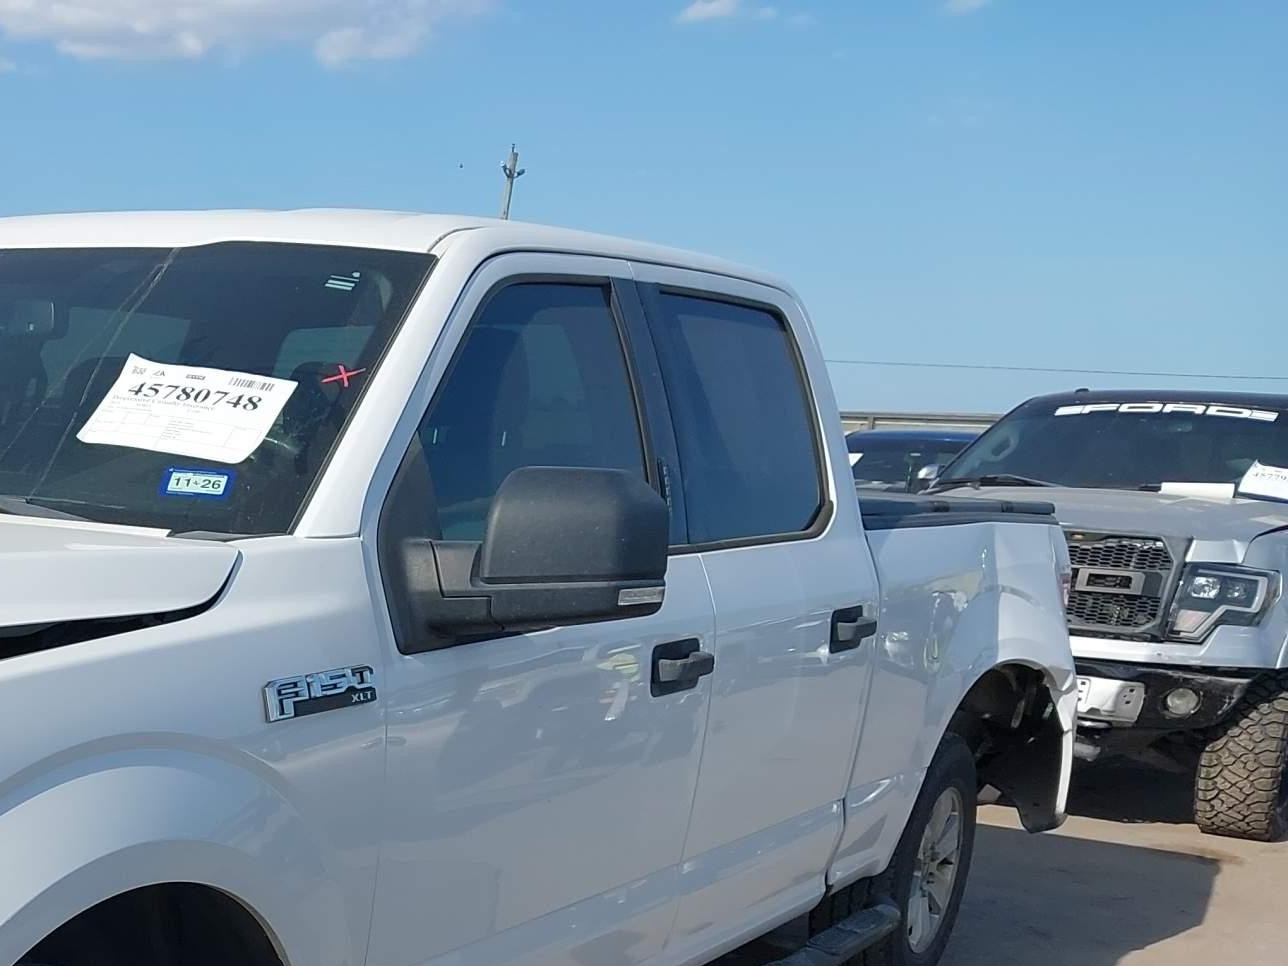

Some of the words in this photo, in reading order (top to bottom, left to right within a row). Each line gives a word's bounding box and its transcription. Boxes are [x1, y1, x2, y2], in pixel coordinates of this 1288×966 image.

[127, 381, 263, 412] 45780748
[1080, 403, 1253, 418] FORD
[351, 691, 373, 703] XLT
